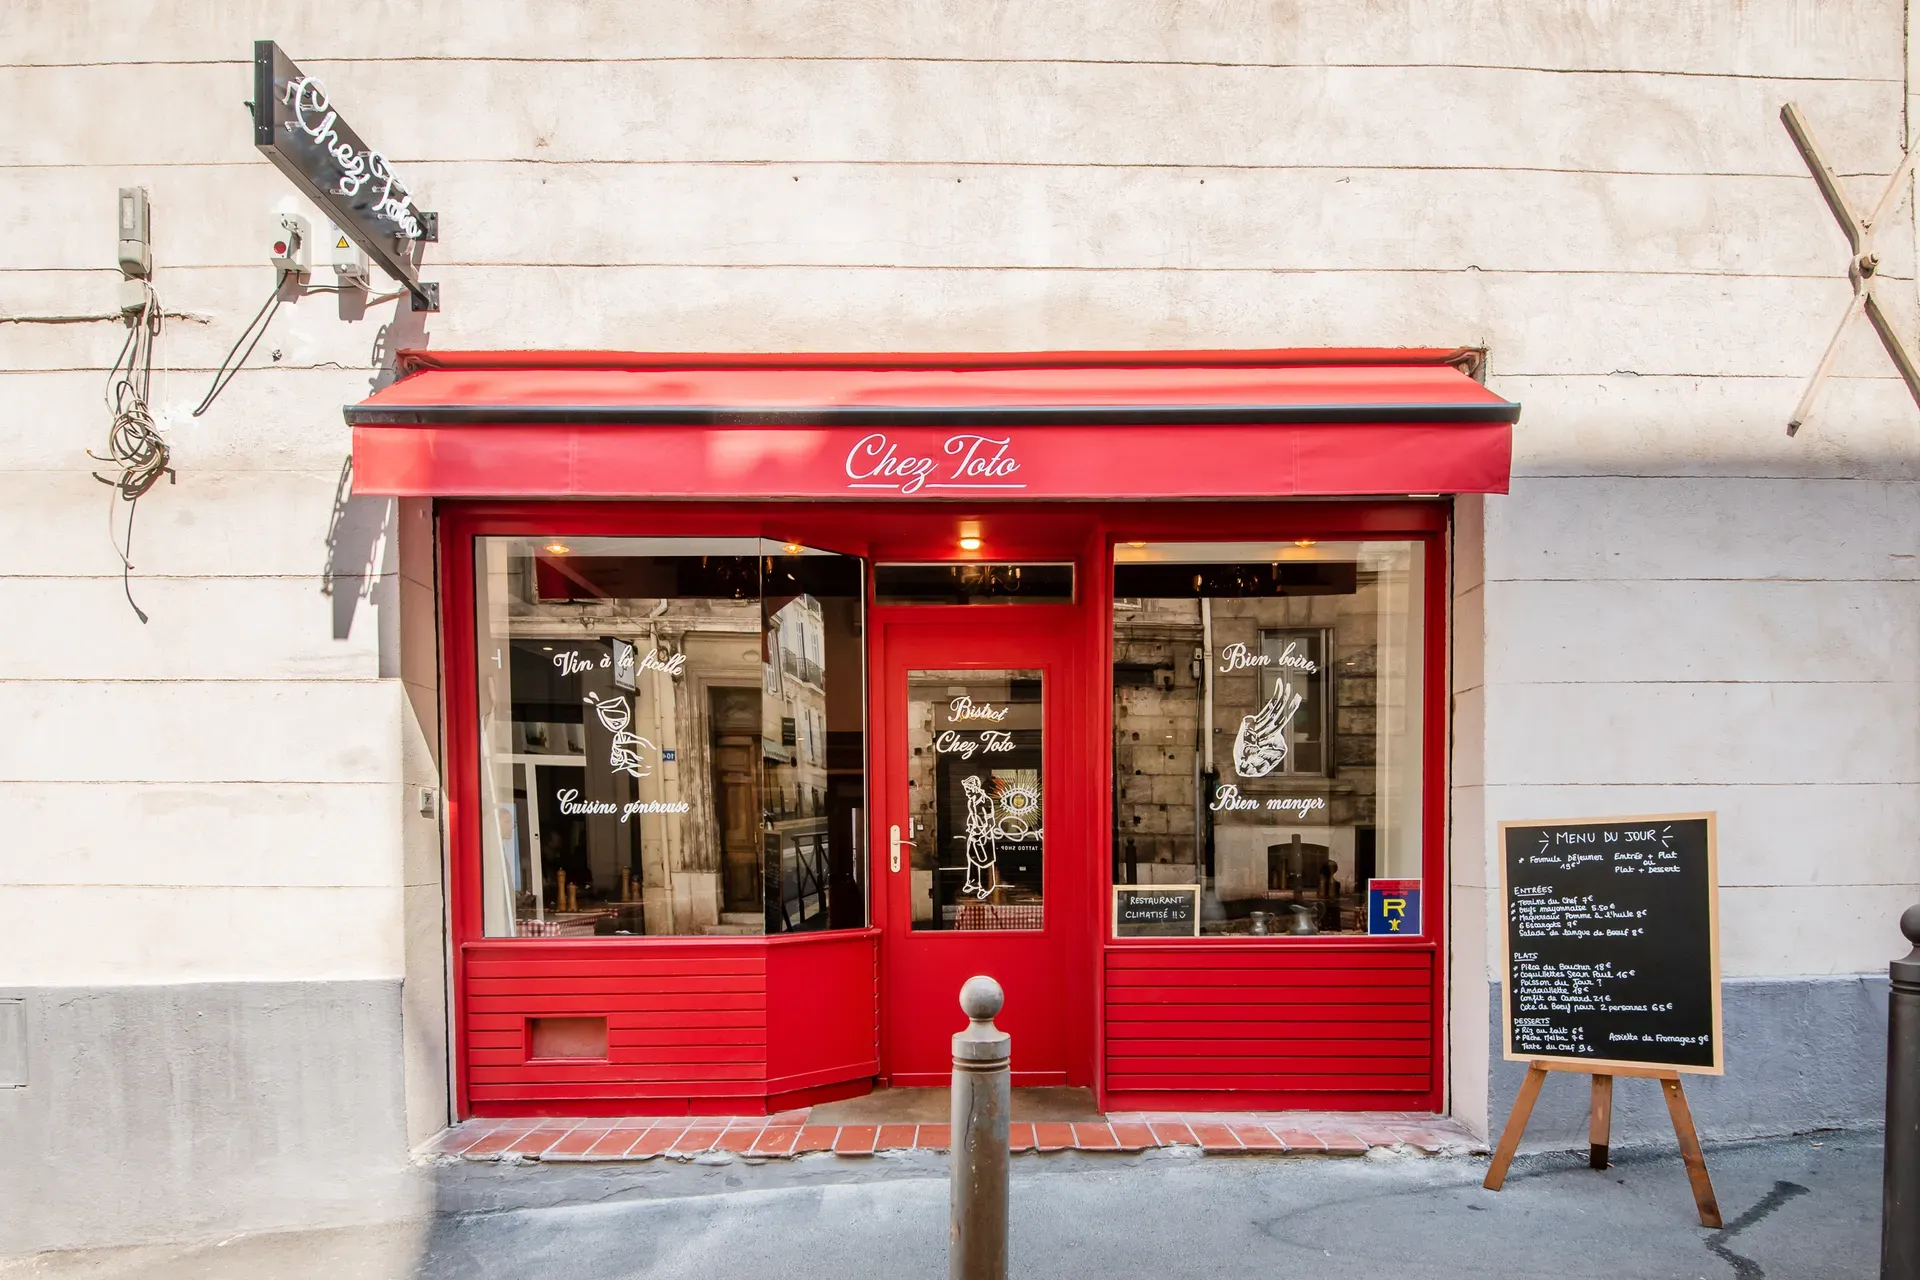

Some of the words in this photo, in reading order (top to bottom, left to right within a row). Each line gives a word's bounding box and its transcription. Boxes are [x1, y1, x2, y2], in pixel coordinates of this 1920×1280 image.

[295, 75, 370, 196] Chez
[845, 433, 939, 494] Chez
[944, 434, 1021, 479] Toto
[553, 651, 593, 677] Vin
[600, 653, 611, 668] à
[617, 645, 634, 669] la
[636, 648, 686, 676] ficelle
[1219, 642, 1270, 673] Bien
[1279, 642, 1318, 675] boire,
[948, 696, 1009, 722] Bistrot
[936, 730, 978, 760] Chez
[980, 730, 1016, 754] Toto
[557, 788, 617, 815] Cuisine
[621, 799, 689, 824] généreuse
[1209, 784, 1260, 811] Bien
[1267, 796, 1325, 819] manger
[1556, 832, 1596, 845] MENU
[1604, 831, 1618, 842] DU
[1624, 829, 1657, 841] JOUR
[1530, 855, 1561, 863] Formule
[1567, 853, 1604, 864] Déjeuner
[1614, 852, 1643, 860] Entrée
[1658, 851, 1678, 859] Plat
[1648, 865, 1680, 873] Dessert
[1514, 885, 1553, 896] ENTRÉES
[1130, 896, 1184, 905] RESTAURANT
[1518, 898, 1546, 906] Terrine
[1562, 896, 1578, 905] Chef
[1383, 899, 1406, 917] R
[1540, 905, 1587, 914] mayonnaise
[1125, 908, 1168, 919] CLIMATISÉ
[1525, 921, 1561, 931] Escargots
[1519, 929, 1546, 937] Salade
[1562, 929, 1591, 939] langue
[1520, 971, 1565, 979] Coquillettes
[1592, 970, 1614, 978] Paul
[1597, 979, 1602, 987] ?
[1520, 995, 1545, 1004] Confit
[1609, 1004, 1647, 1012] personnes
[1514, 1017, 1550, 1025] DESSERTS
[1521, 1027, 1533, 1035] Riz
[1609, 1032, 1638, 1041] Assiette
[1642, 1034, 1654, 1042] de
[1656, 1034, 1696, 1046] Fromages
[1559, 1044, 1575, 1052] Chef
